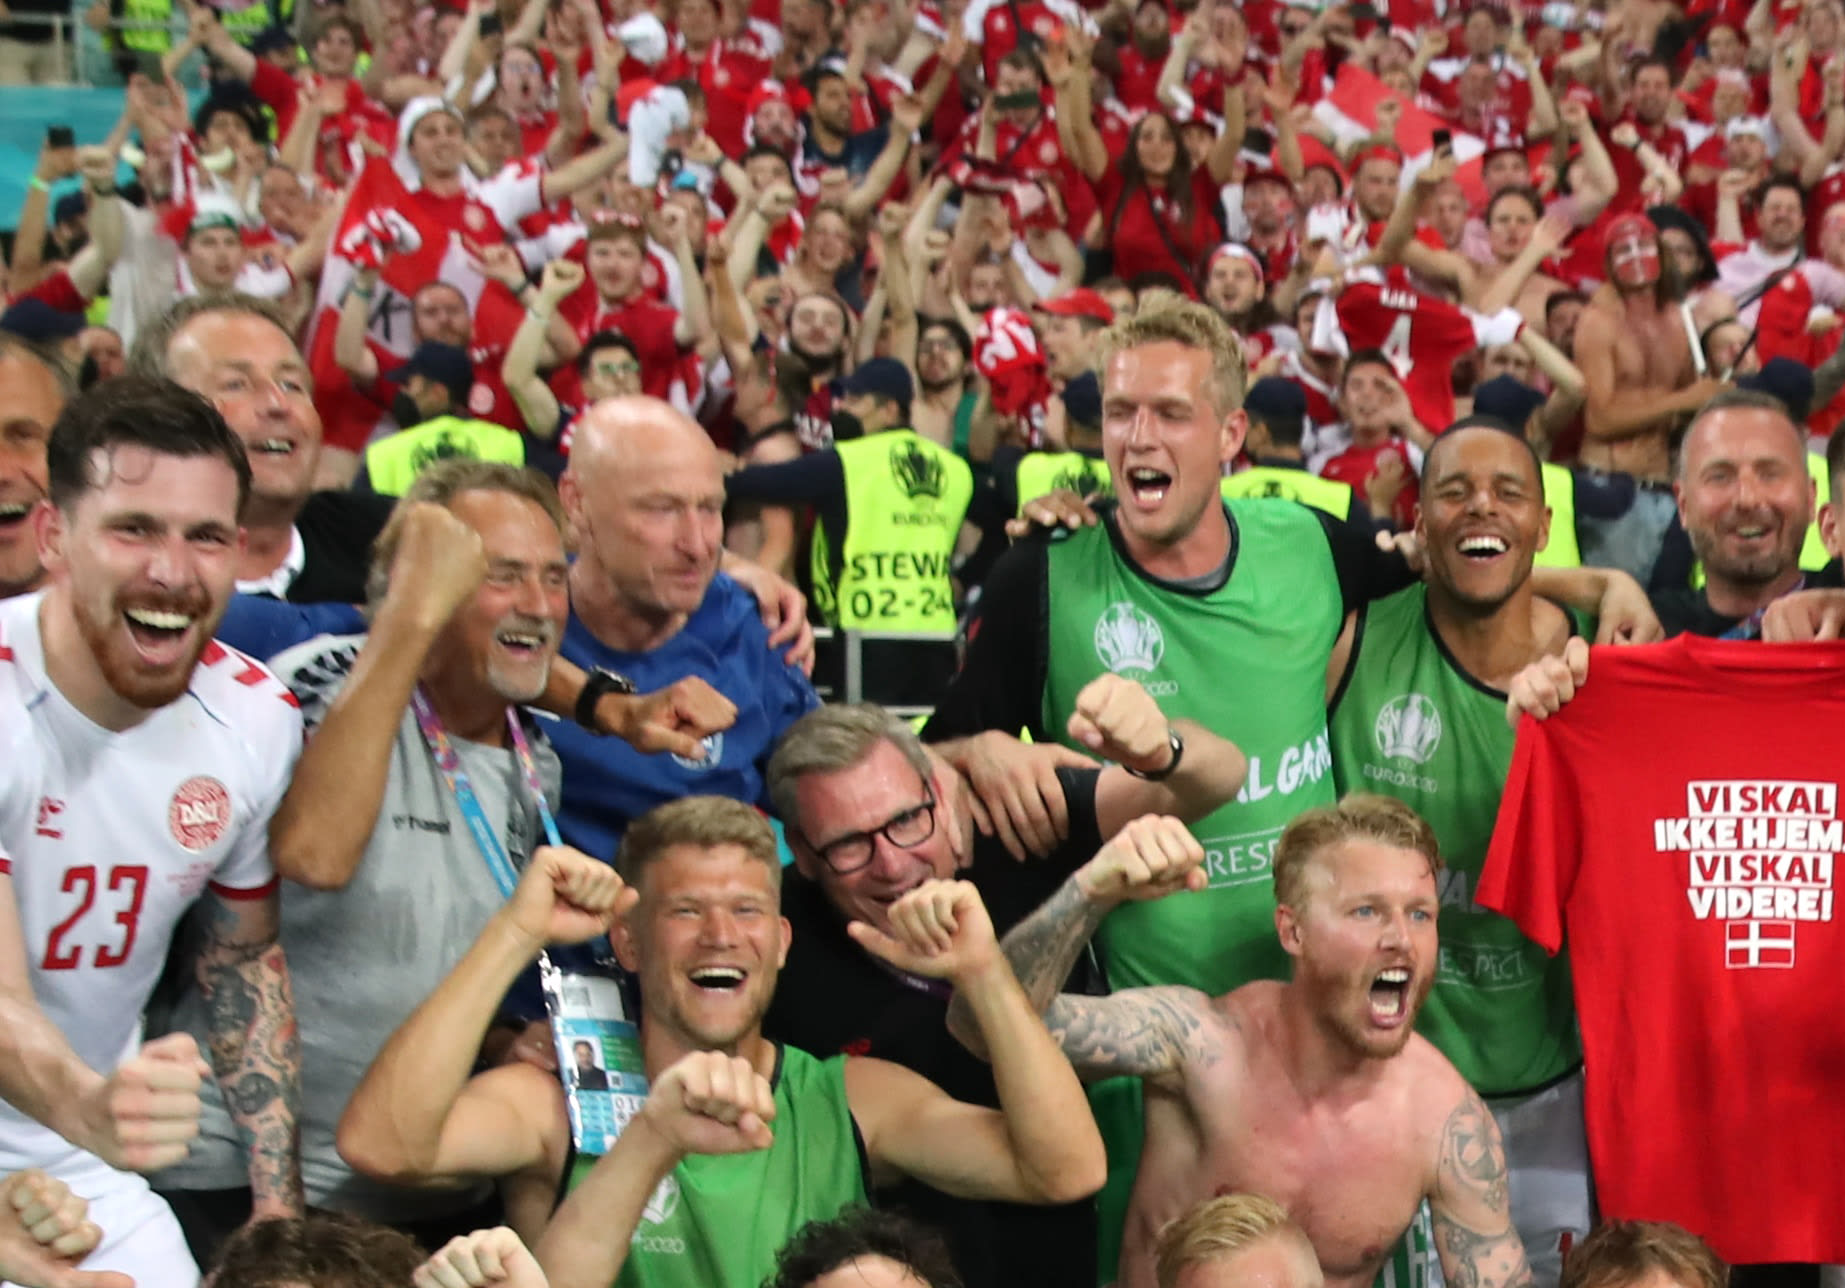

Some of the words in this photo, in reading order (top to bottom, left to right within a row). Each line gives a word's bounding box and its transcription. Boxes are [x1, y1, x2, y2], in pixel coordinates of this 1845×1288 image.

[1381, 313, 1413, 380] 4
[1693, 786, 1732, 814] VI
[1738, 785, 1831, 815] SKAL
[1654, 818, 1739, 852] IKKE
[1695, 854, 1732, 883] VI
[1739, 854, 1827, 885] SKAL
[41, 864, 149, 970] 23
[1687, 887, 1834, 922] VIDERE!
[1440, 946, 1525, 981] ESPECT
